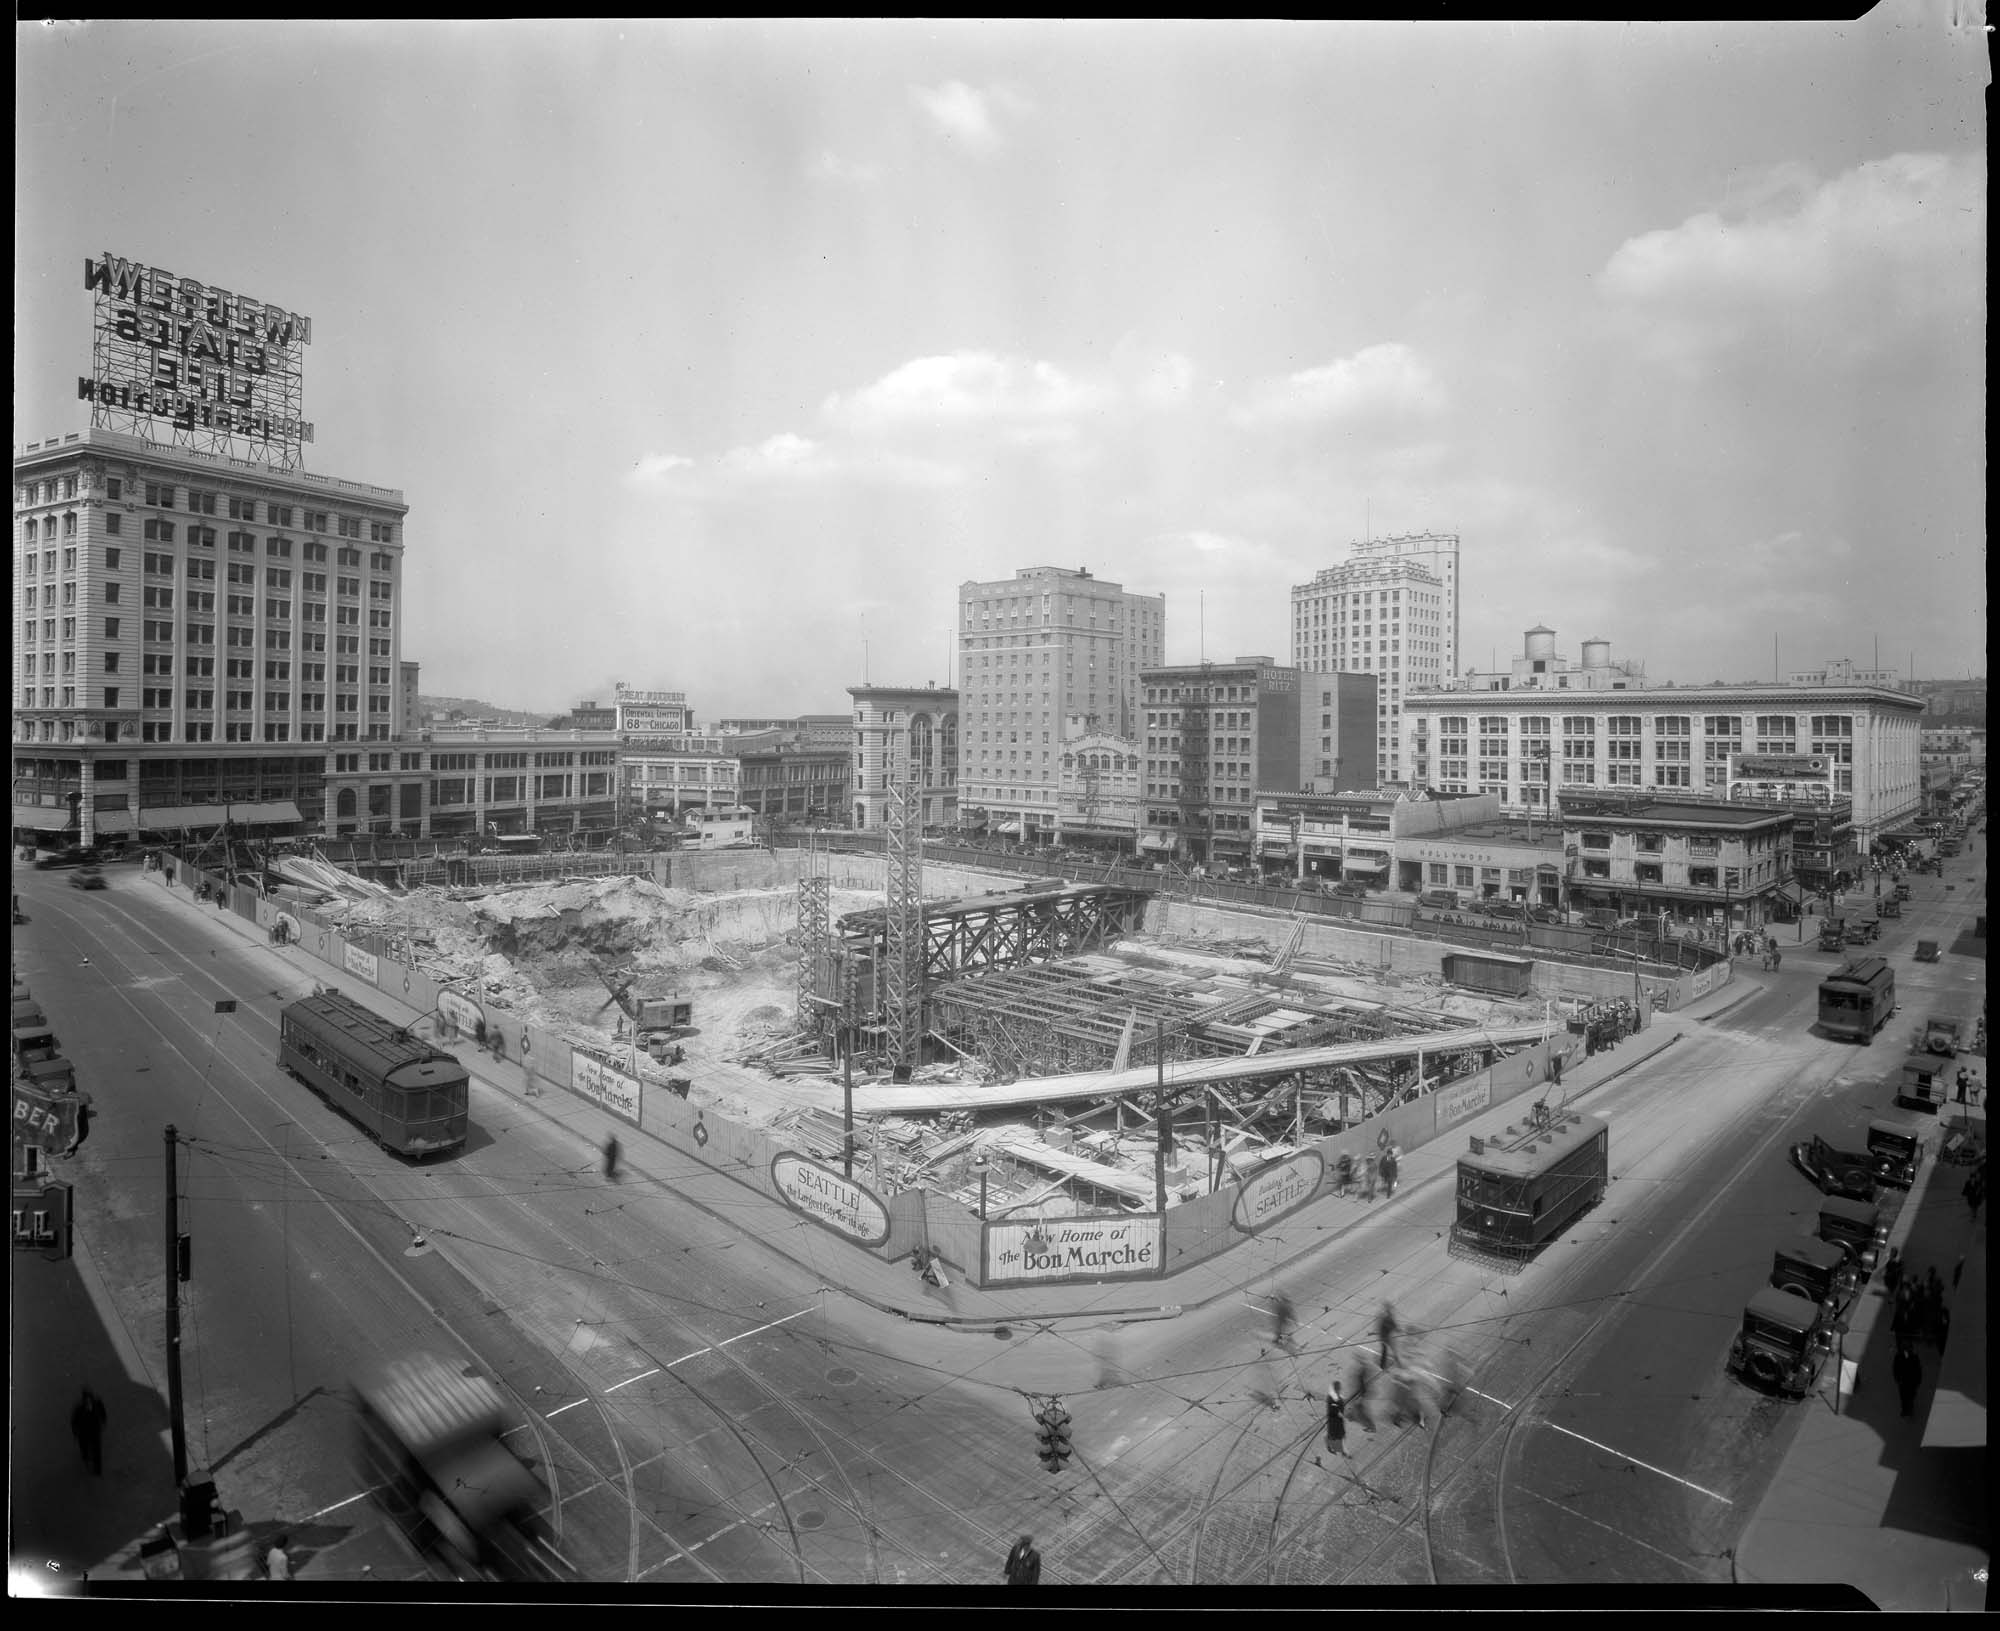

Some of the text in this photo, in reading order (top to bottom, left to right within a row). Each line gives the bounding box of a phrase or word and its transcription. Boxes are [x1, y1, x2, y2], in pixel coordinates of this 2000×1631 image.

[103, 252, 312, 346] WESTERN
[135, 304, 286, 372] STATES
[151, 346, 252, 400] LIFE
[127, 380, 314, 444] PROTECTION
[1263, 669, 1297, 681] HOTEL
[618, 690, 644, 700] GREAT
[625, 708, 680, 719] ORIENTAL LIMITED
[626, 718, 640, 730] 68
[650, 719, 679, 730] CHICAGO
[1419, 848, 1492, 862] HOLLYWOOD
[797, 1167, 861, 1211] SEATTLE
[1255, 1177, 1306, 1218] SEATTLE
[1059, 1229, 1104, 1244] Home
[1109, 1225, 1130, 1241] of
[1023, 1250, 1064, 1271] Bon
[1063, 1242, 1153, 1269] Marché
